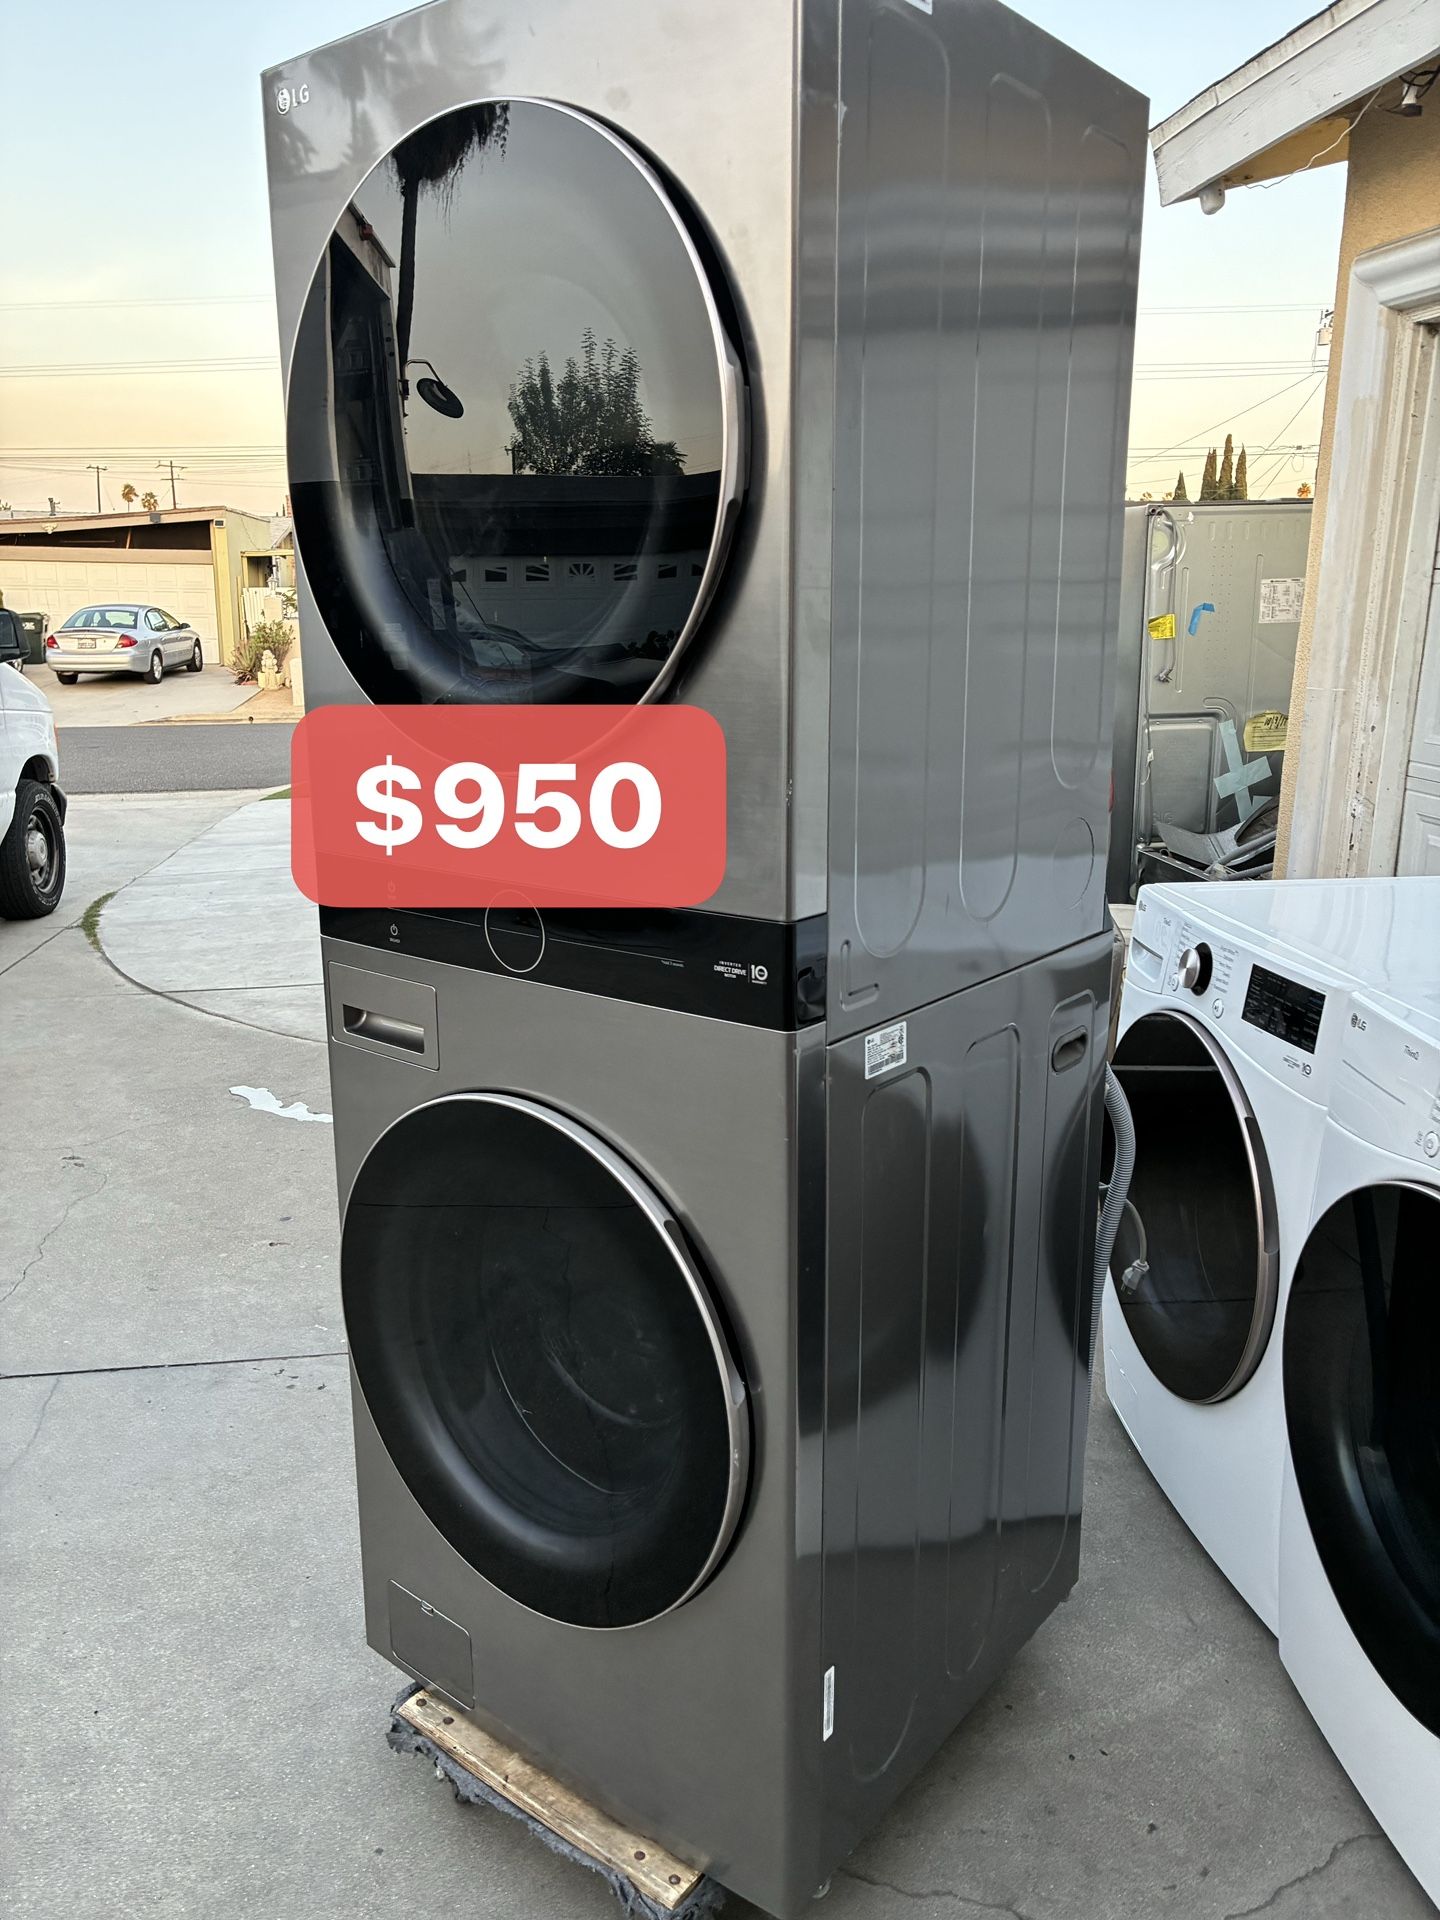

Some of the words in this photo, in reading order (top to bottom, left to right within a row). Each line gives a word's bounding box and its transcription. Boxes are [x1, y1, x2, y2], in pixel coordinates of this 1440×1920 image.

[714, 965, 731, 973] DIRECT
[732, 968, 747, 976] DRIVE
[751, 964, 768, 980] 10
